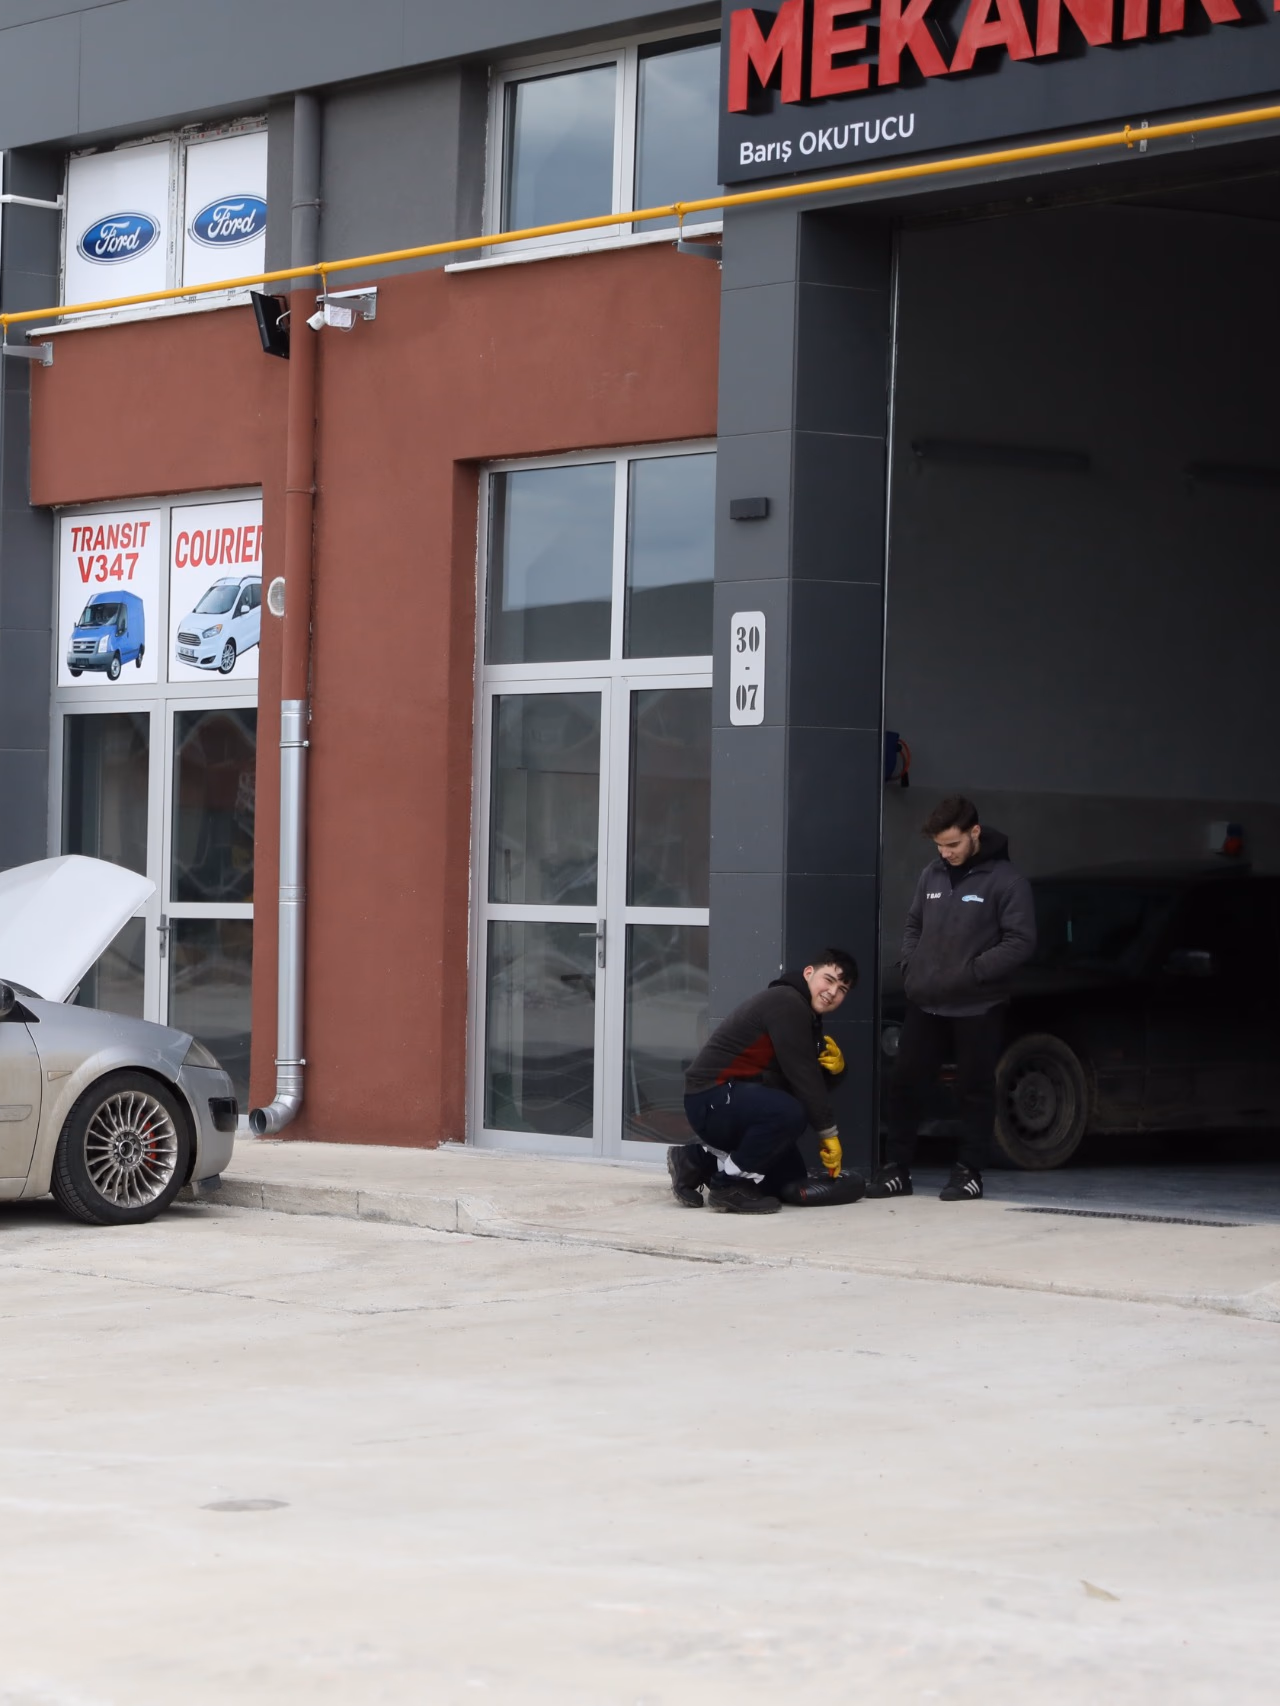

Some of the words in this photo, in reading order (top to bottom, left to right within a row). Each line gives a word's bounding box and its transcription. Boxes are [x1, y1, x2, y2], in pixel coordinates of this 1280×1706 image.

[740, 140, 792, 165] Barış
[799, 113, 915, 155] OKUTUCU
[208, 203, 257, 238] Ford
[95, 220, 140, 255] Ford
[71, 521, 151, 552] TRANSIT
[77, 553, 139, 583] V347
[736, 626, 760, 652] 30
[736, 684, 759, 711] 07
